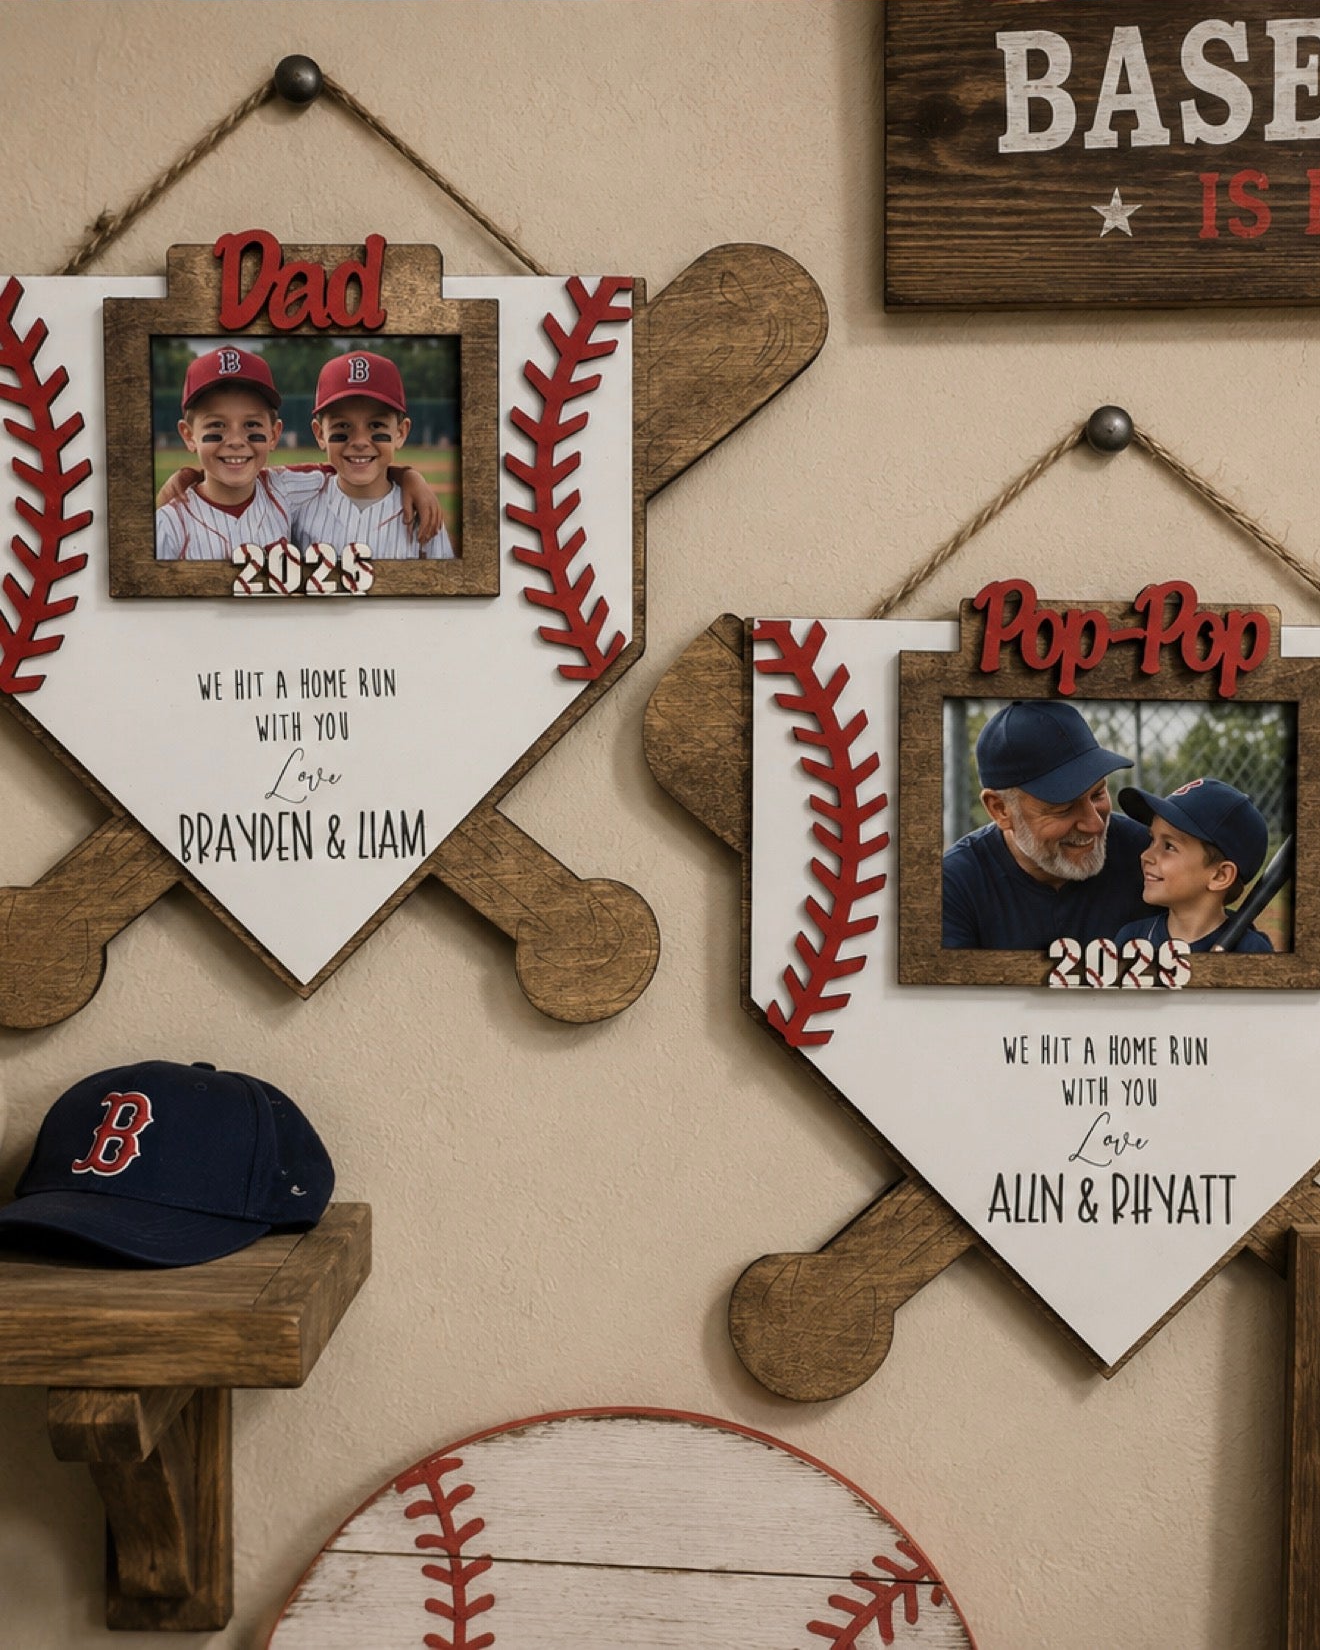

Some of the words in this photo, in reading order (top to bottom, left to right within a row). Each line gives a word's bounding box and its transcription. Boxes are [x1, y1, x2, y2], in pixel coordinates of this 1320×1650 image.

[1199, 168, 1272, 239] IS
[213, 229, 387, 330] Dad
[347, 356, 370, 383] B
[232, 542, 374, 594] 2026
[973, 578, 1272, 698] Pop-Pop
[197, 671, 223, 701] WE
[235, 668, 265, 701] HIT
[275, 669, 288, 700] A
[300, 667, 348, 700] HOME
[358, 666, 396, 698] RUN
[255, 711, 302, 743] WITH
[313, 710, 350, 742] YOU
[265, 748, 343, 804] Love
[179, 809, 314, 865] BRAYDEN
[326, 813, 346, 860] &
[357, 808, 427, 860] LIAM
[1002, 1034, 1030, 1066] WE
[1040, 1034, 1072, 1066] HIT
[1083, 1036, 1097, 1065] A
[1109, 1034, 1158, 1067] HOME
[1168, 1034, 1208, 1067] RUN
[1062, 1075, 1109, 1107] WITH
[1120, 1077, 1158, 1108] YOU
[71, 1091, 154, 1177] B
[1068, 1111, 1150, 1168] Love
[1077, 1176, 1100, 1225] &
[1111, 1171, 1238, 1226] RHYATT
